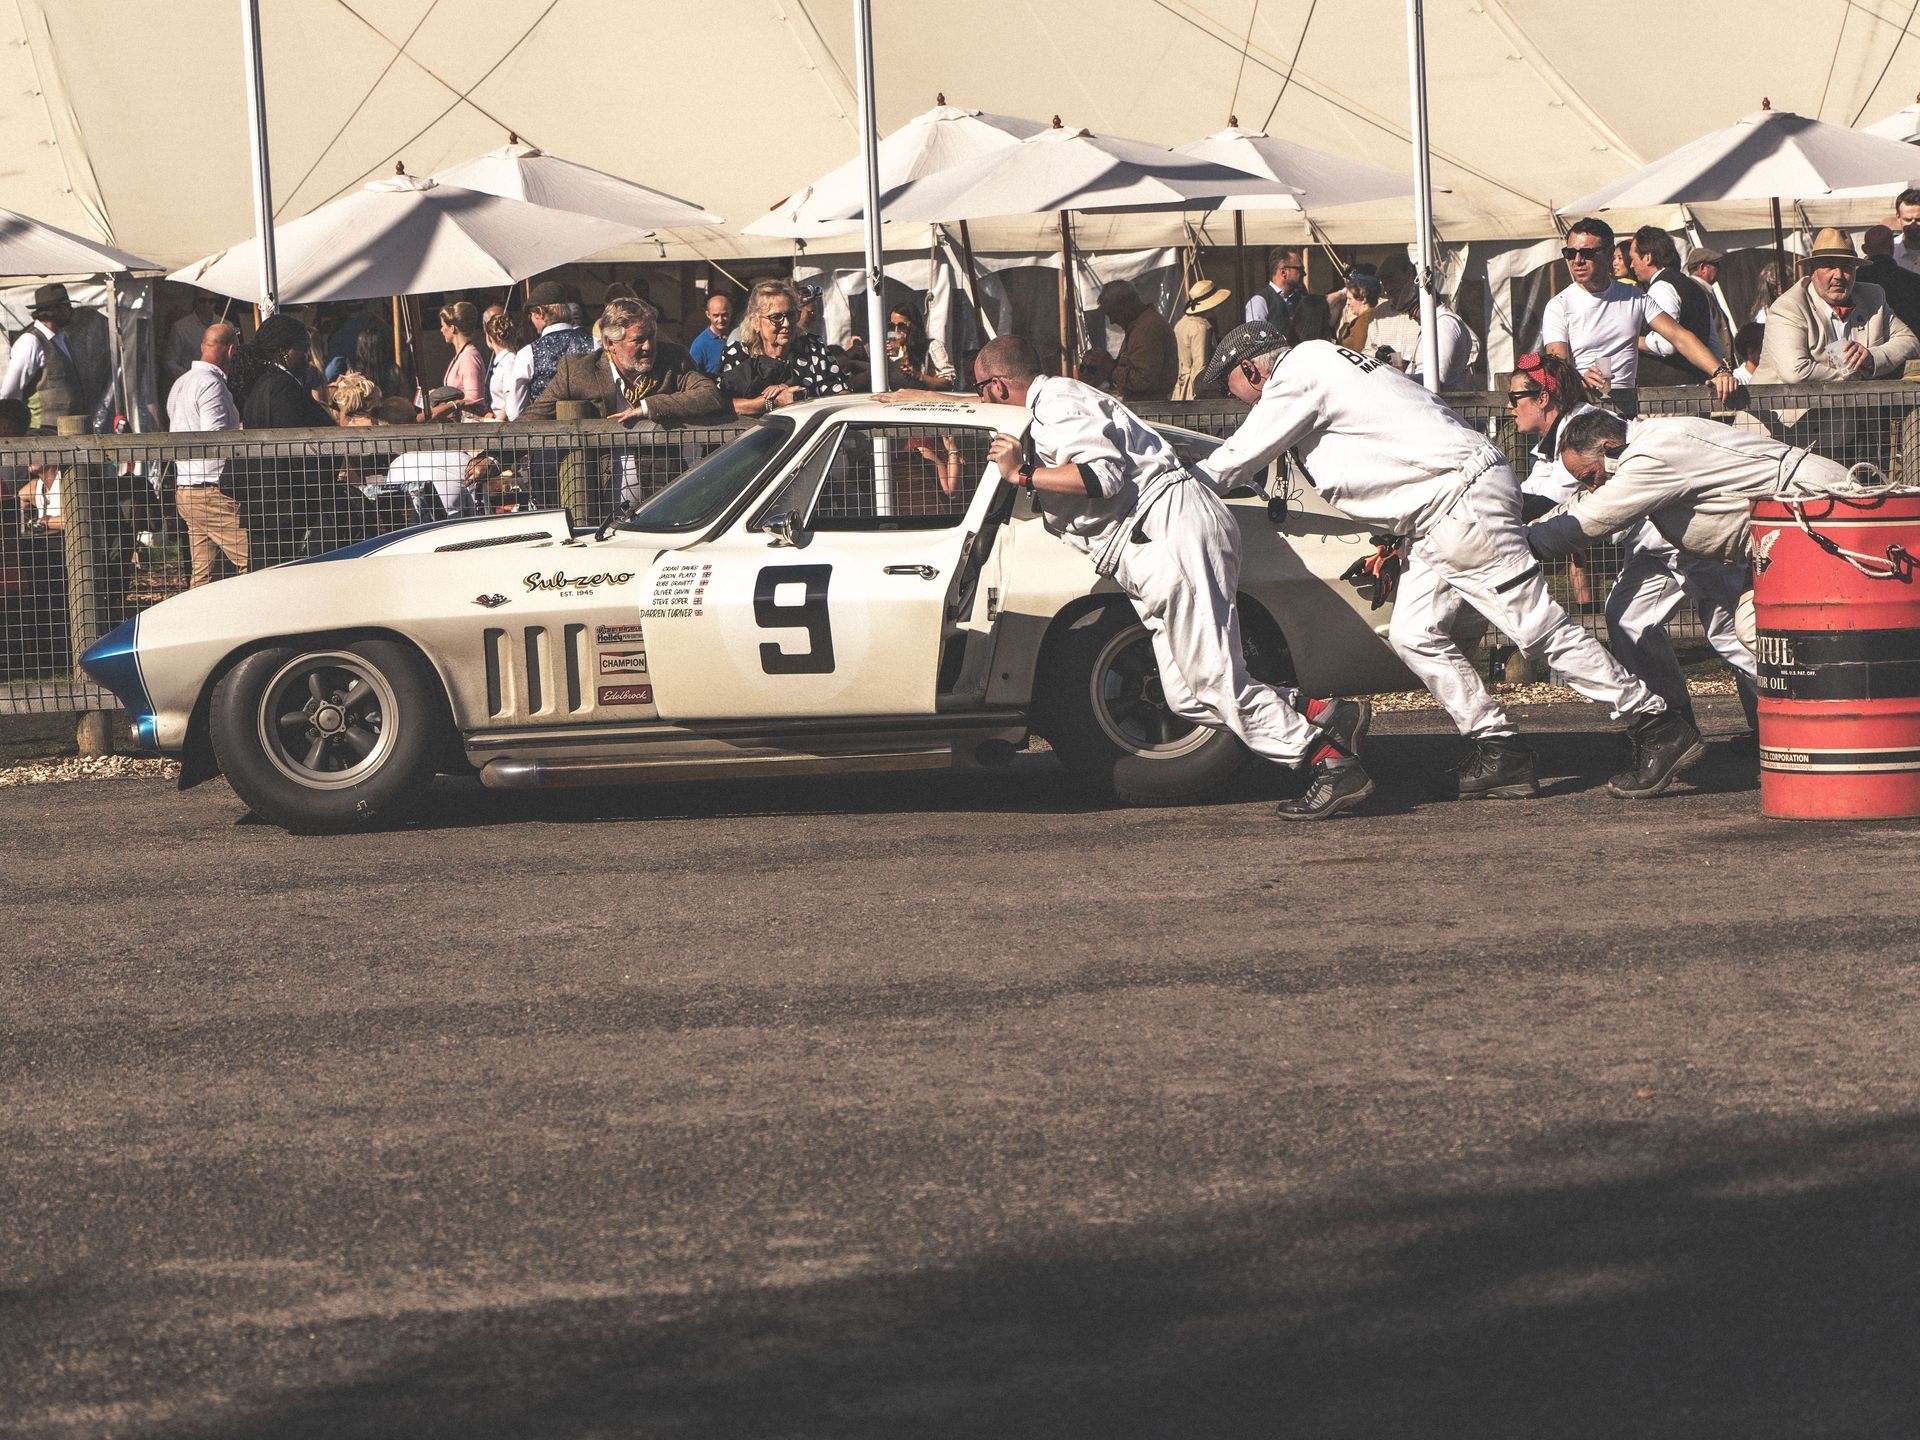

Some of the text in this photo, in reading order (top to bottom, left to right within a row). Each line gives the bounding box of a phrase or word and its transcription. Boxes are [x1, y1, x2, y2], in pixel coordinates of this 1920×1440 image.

[523, 571, 636, 593] Sub-zero
[576, 589, 594, 597] 1945
[653, 588, 672, 596] OLIVER
[671, 597, 689, 605] SOPER
[640, 608, 693, 619] DARREN TURNER
[753, 564, 836, 675] 9
[597, 633, 623, 642] Holley
[602, 658, 645, 668] CHAMPION
[1770, 677, 1787, 690] OIL
[603, 690, 647, 700] Edelbrock
[1769, 752, 1809, 763] CORPORATION
